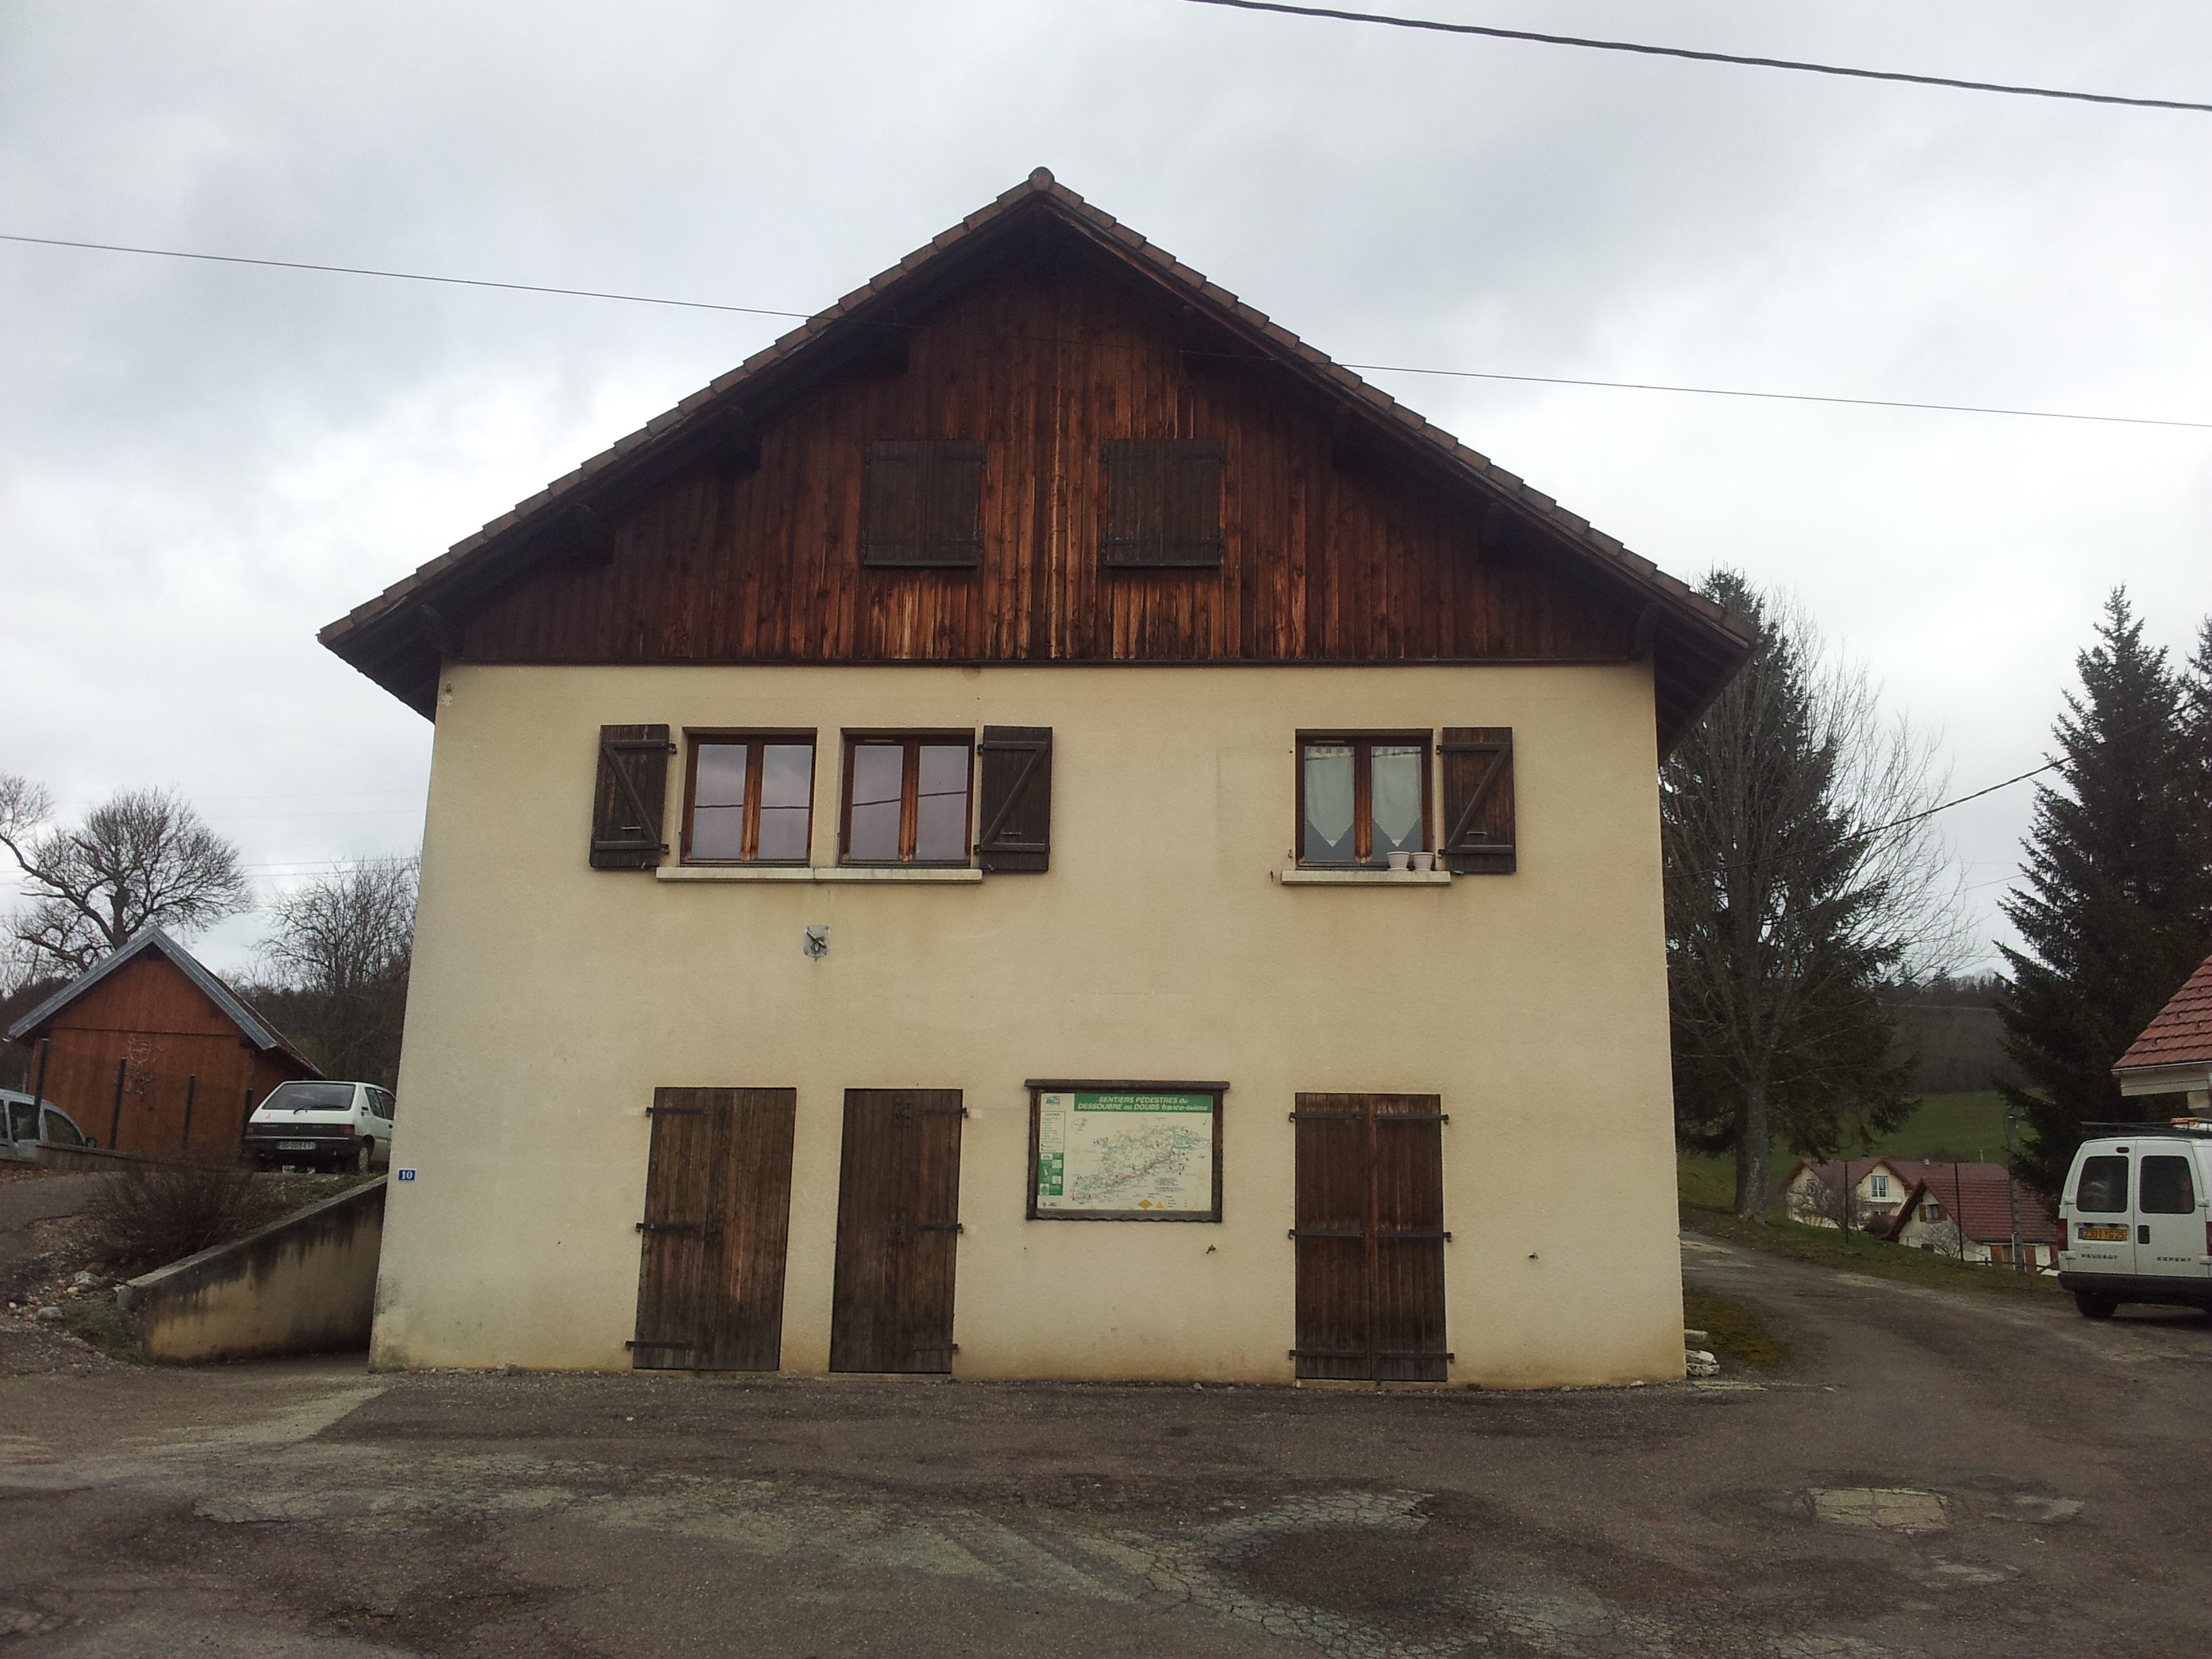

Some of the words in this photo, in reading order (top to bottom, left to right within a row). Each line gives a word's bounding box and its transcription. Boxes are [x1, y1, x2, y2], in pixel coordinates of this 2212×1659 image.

[401, 1170, 413, 1179] 10
[2083, 1229, 2102, 1238] 2301
[2104, 1230, 2114, 1239] YG
[2115, 1231, 2125, 1239] 25
